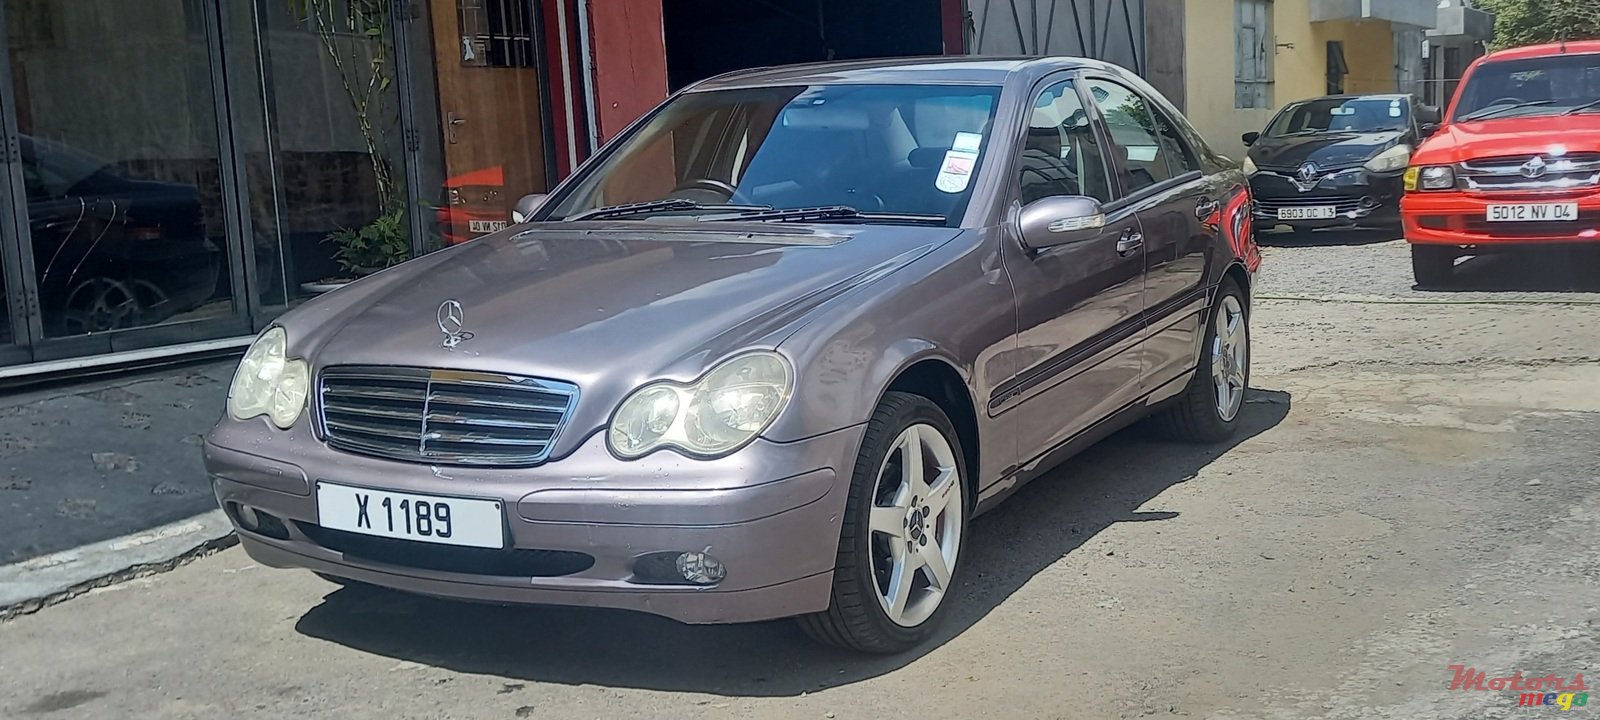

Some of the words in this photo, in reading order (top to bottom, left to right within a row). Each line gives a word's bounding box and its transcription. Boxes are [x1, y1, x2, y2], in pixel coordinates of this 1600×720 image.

[1281, 209, 1304, 219] 6903
[1322, 207, 1334, 217] 13
[1493, 206, 1525, 219] 5012
[1531, 205, 1548, 219] NV
[1554, 204, 1570, 218] 04
[355, 493, 371, 529] X
[382, 496, 452, 538] 1189
